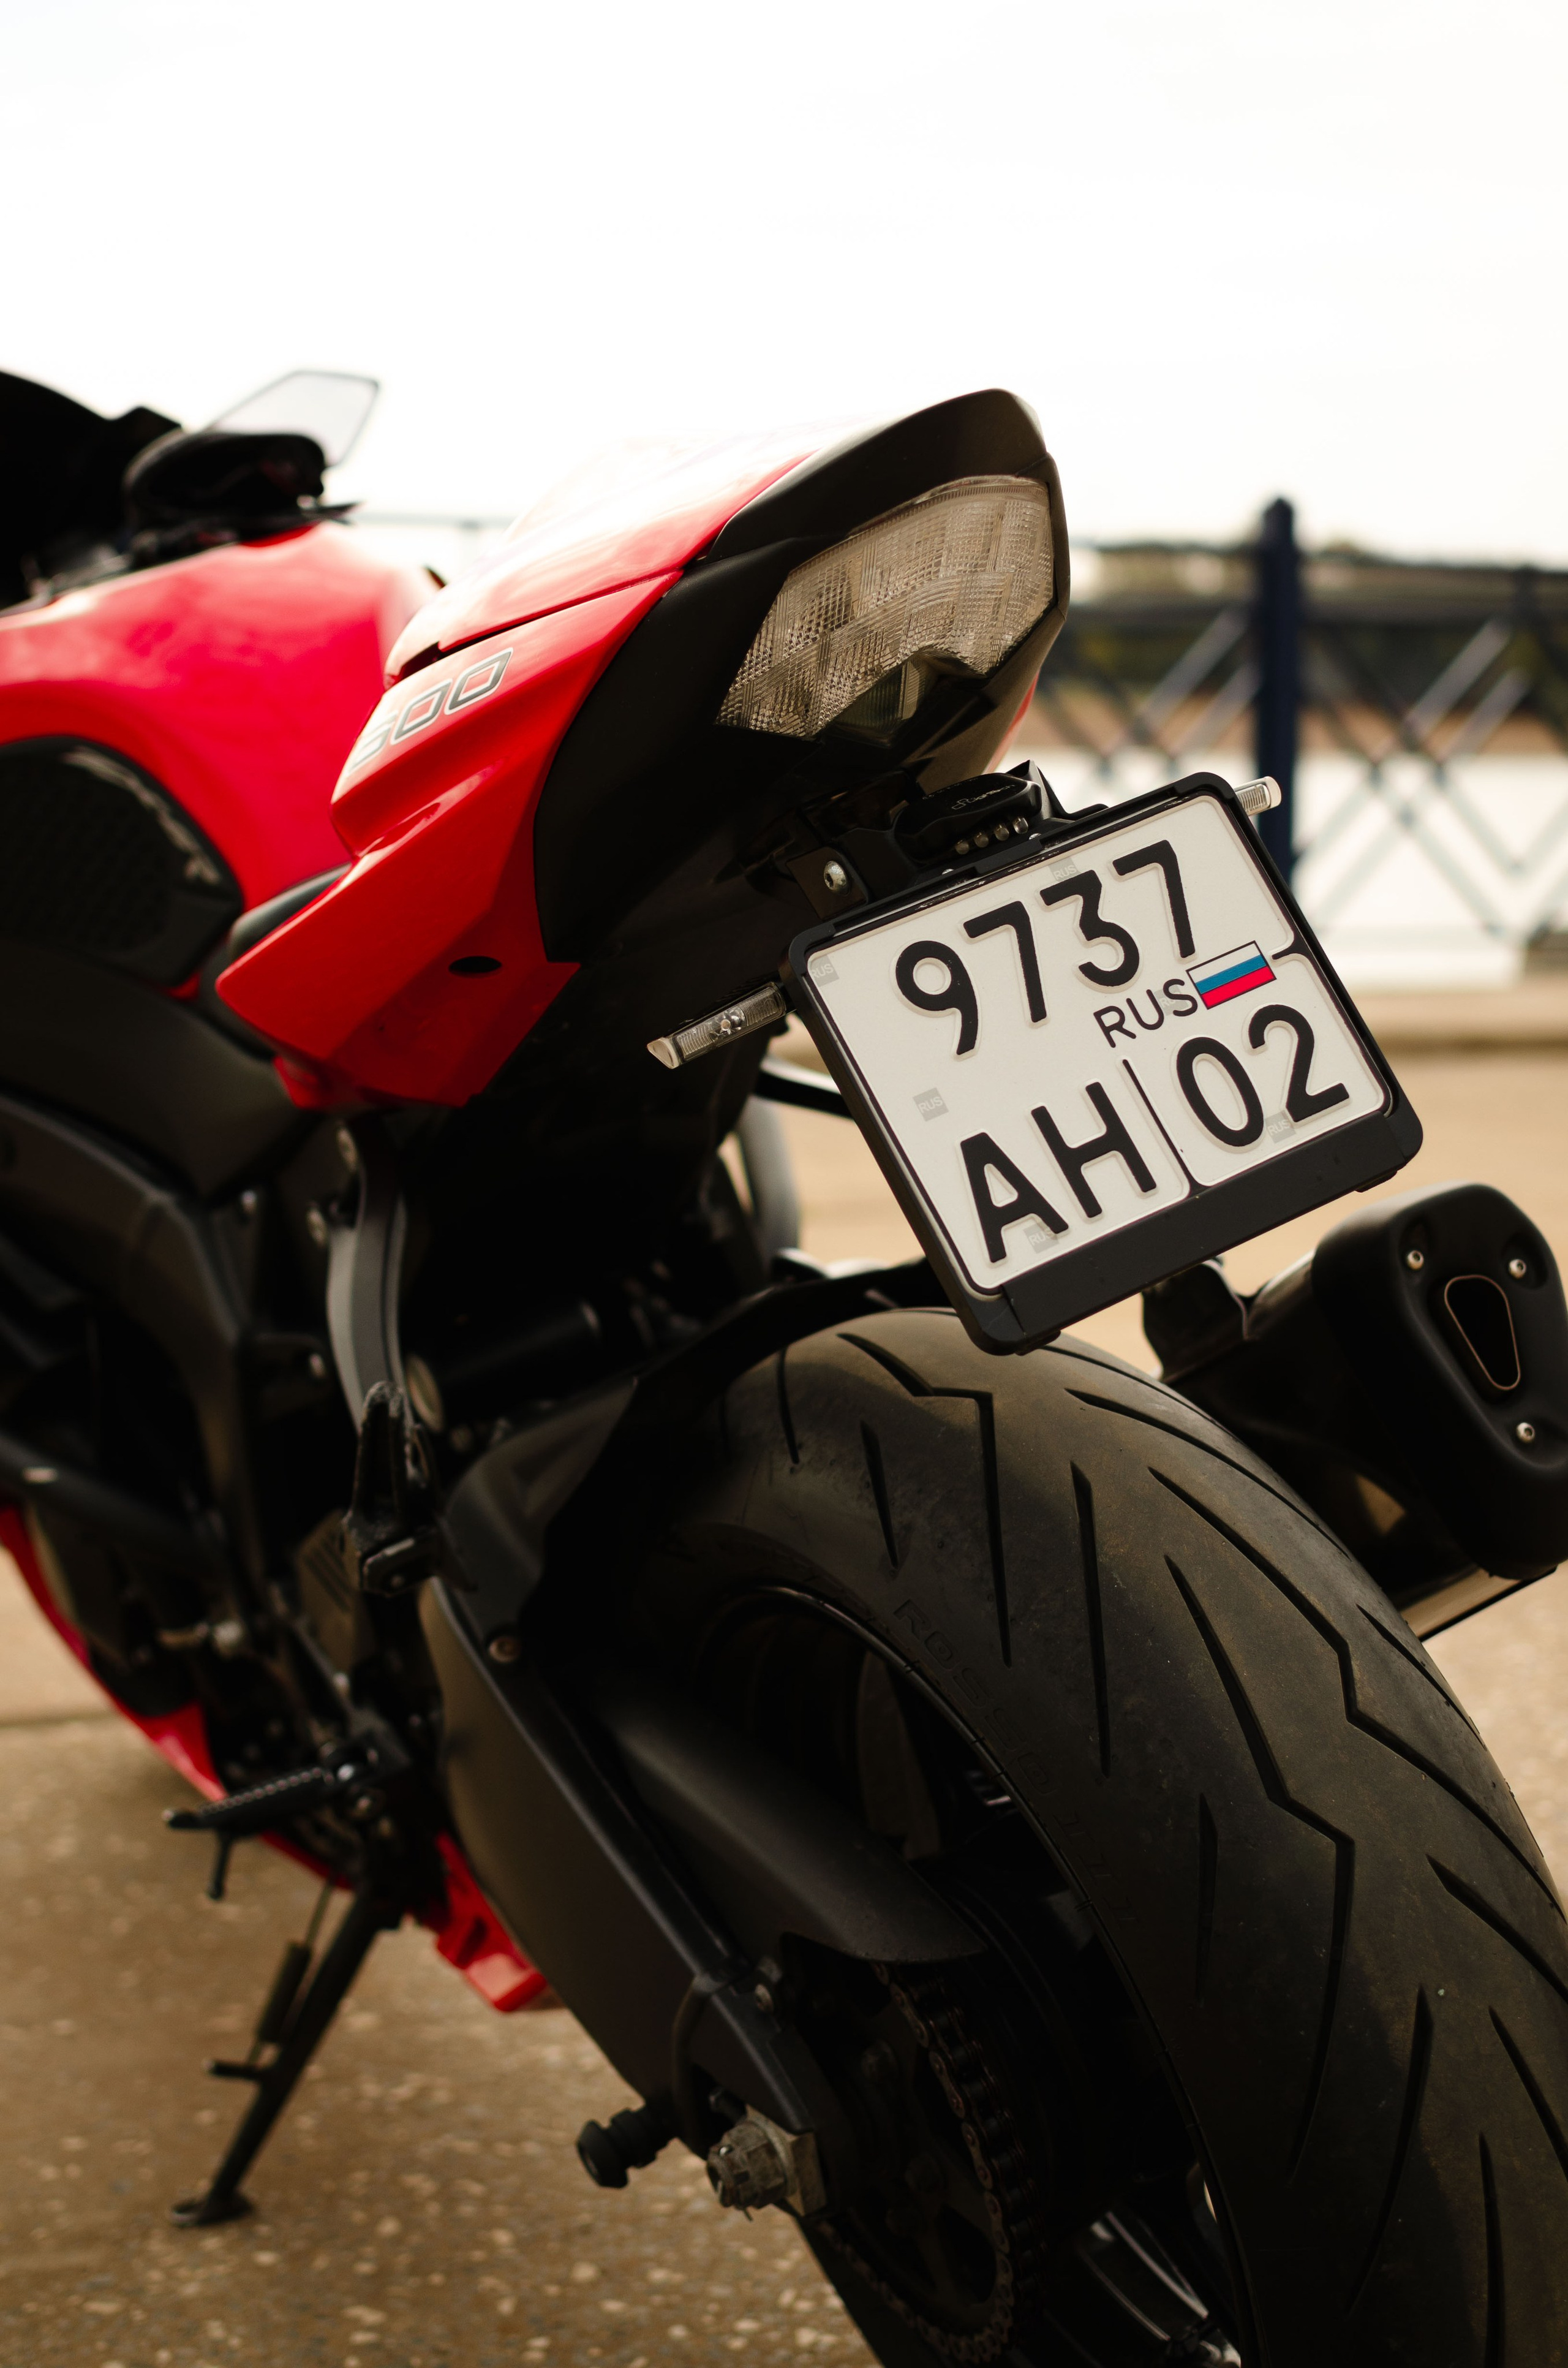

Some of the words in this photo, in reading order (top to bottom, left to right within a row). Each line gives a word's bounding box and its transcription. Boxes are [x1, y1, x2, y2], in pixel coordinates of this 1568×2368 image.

[1054, 864, 1077, 880] RUS
[811, 963, 834, 979] RUS
[895, 839, 1196, 1055] 9737
[1093, 978, 1197, 1048] RUS
[919, 1097, 943, 1113] RUS
[1176, 1004, 1349, 1146] 02
[1268, 1119, 1291, 1136] RUS
[960, 1081, 1156, 1263] AH
[893, 1598, 1058, 1794] ROSSO
